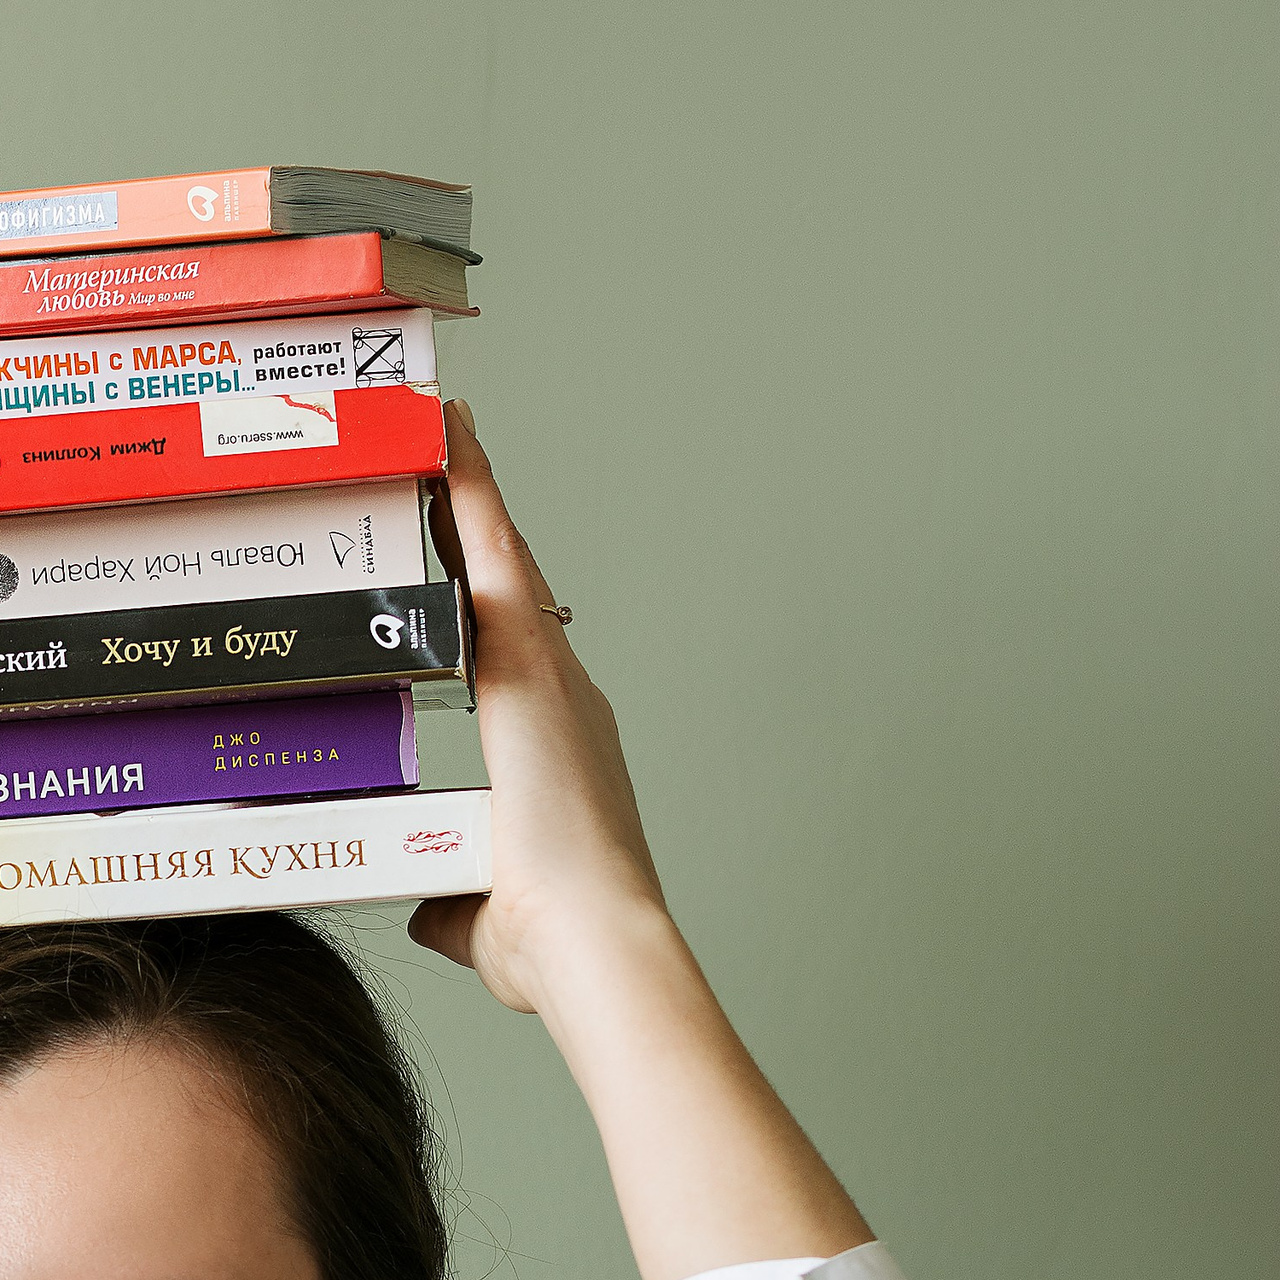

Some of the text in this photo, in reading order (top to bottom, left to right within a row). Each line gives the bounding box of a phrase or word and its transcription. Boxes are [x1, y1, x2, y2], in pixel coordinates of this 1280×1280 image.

[22, 259, 200, 297] Материнская
[37, 286, 195, 314] любовь Мир во мне
[109, 350, 123, 369] с
[133, 340, 243, 371] МАРСА,
[253, 340, 342, 364] работают
[255, 358, 347, 383] вместе!
[106, 380, 119, 399] с
[22, 437, 166, 464] Джим Коллинз
[217, 430, 304, 446] www.sseru.org
[31, 542, 304, 585] Юваль Ной Харари
[101, 637, 178, 667] Хочу
[191, 636, 213, 656] и
[225, 625, 298, 659] буду
[213, 732, 260, 749] ДЖО
[214, 748, 340, 771] ДИСПЕНЗА
[228, 839, 368, 879] КУХНЯ
